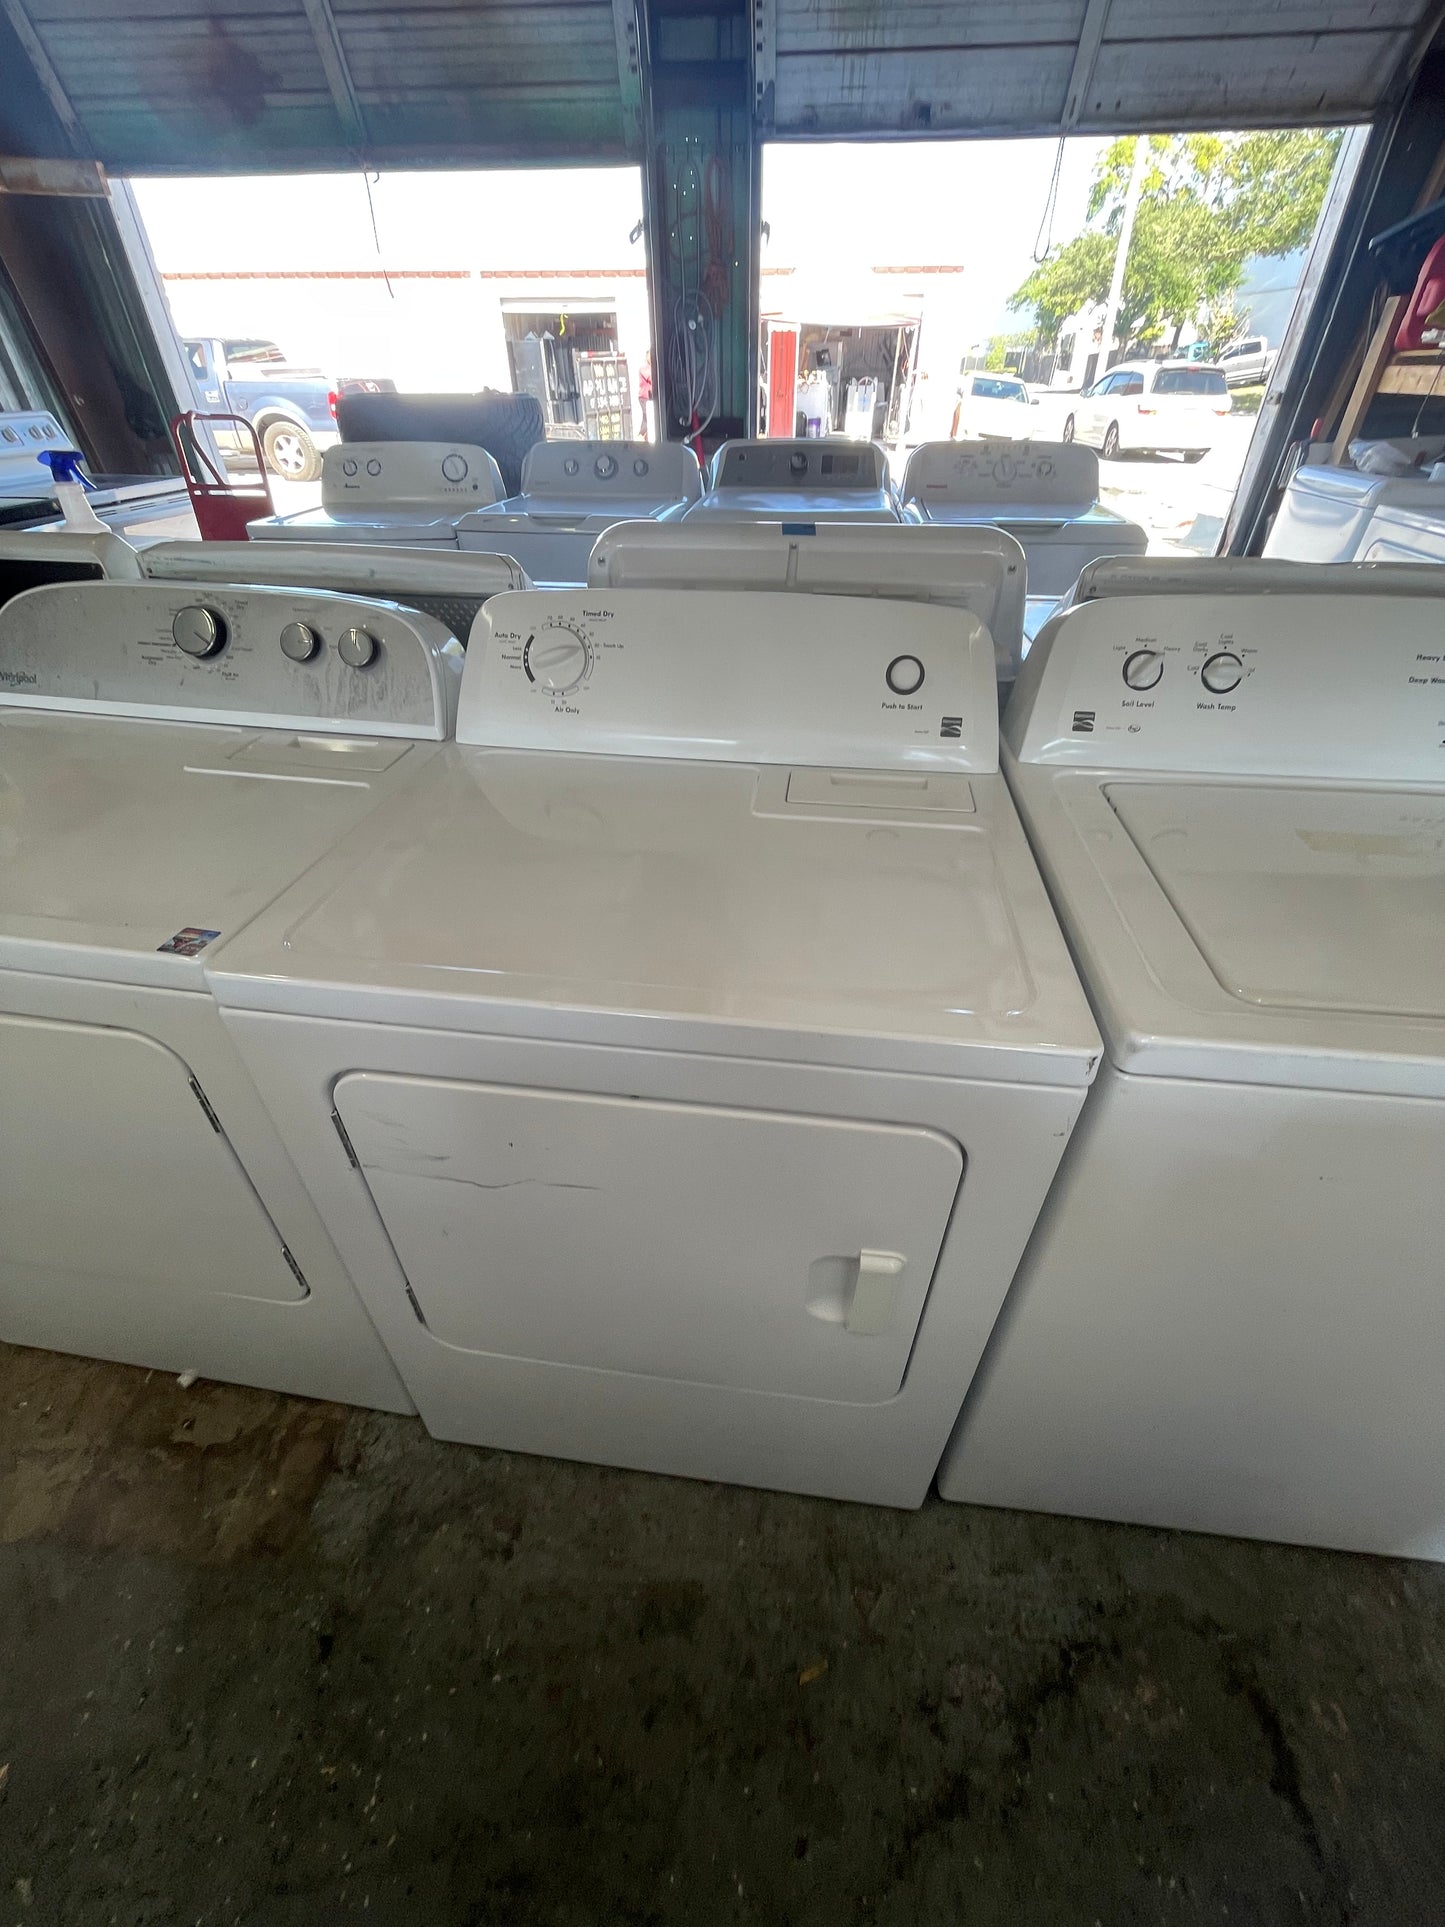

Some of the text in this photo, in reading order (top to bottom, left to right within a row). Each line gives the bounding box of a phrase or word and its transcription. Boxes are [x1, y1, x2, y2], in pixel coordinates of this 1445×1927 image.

[510, 632, 521, 640] Dry
[1416, 654, 1440, 663] Heavy
[1408, 676, 1429, 685] Deep
[881, 702, 897, 710] Push
[1136, 700, 1155, 708] Level
[1196, 702, 1237, 712] Wash Temp
[565, 707, 580, 715] Only
